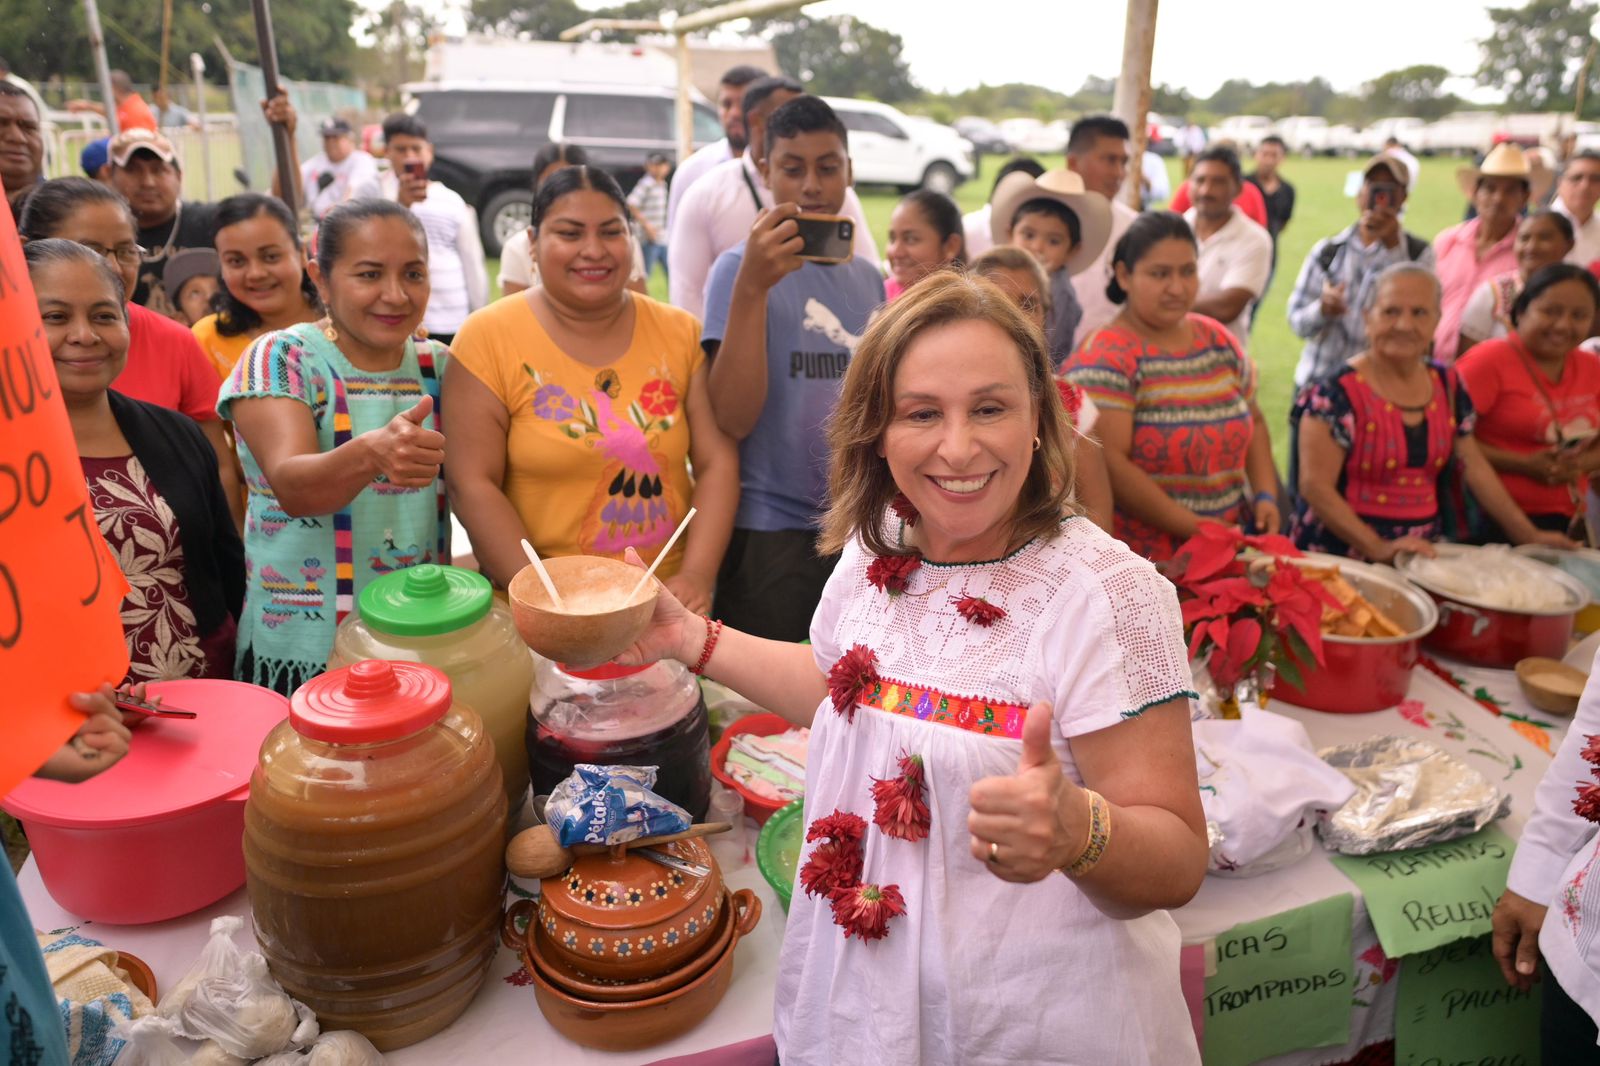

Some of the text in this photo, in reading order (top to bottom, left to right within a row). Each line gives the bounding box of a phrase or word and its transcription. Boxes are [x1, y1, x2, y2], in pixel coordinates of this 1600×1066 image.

[789, 351, 848, 379] PUMA
[1402, 885, 1500, 931] RELLEN
[1203, 968, 1347, 1017] TROMPADAS
